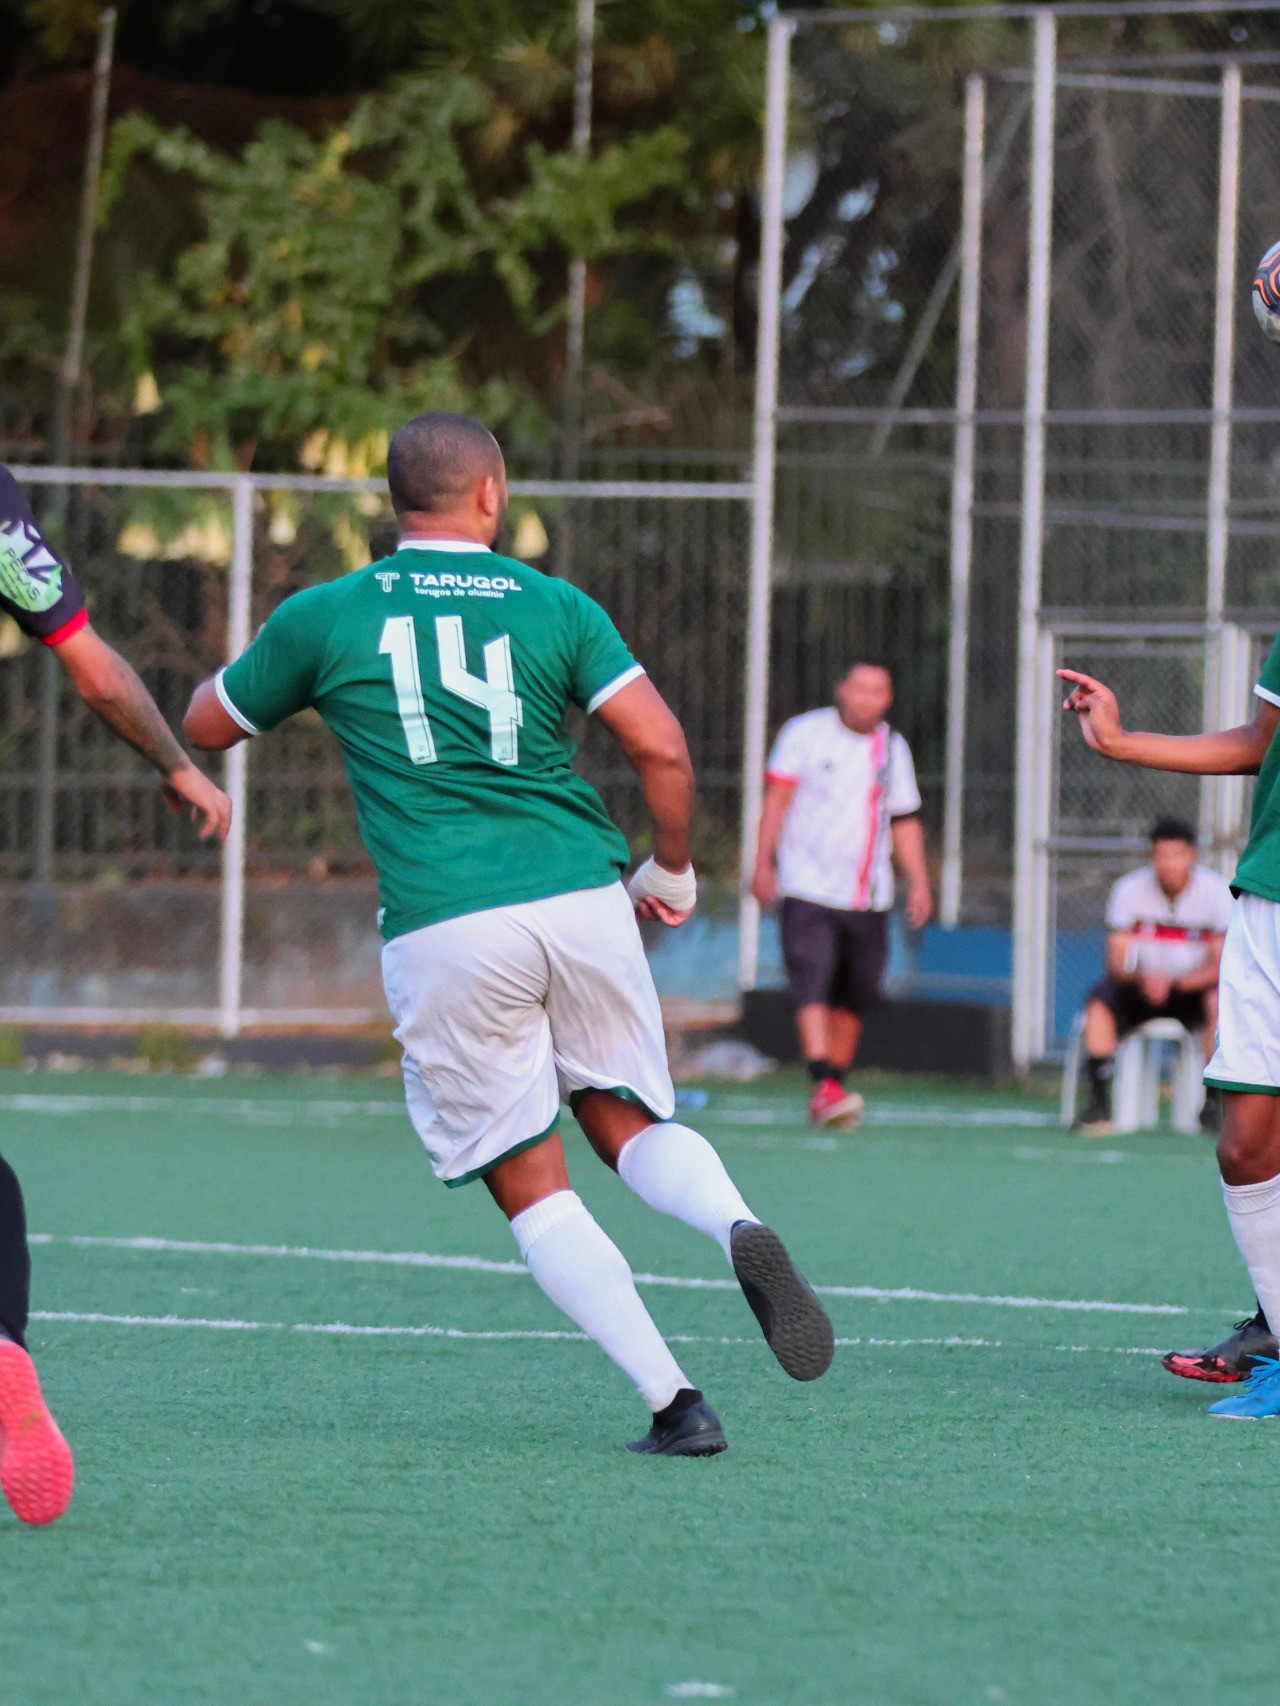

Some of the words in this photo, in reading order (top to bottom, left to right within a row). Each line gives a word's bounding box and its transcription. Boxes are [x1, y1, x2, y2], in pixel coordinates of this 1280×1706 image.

[409, 573, 523, 591] TARUGOL
[414, 587, 452, 598] tarugos
[453, 587, 466, 597] de
[378, 615, 524, 766] 14
